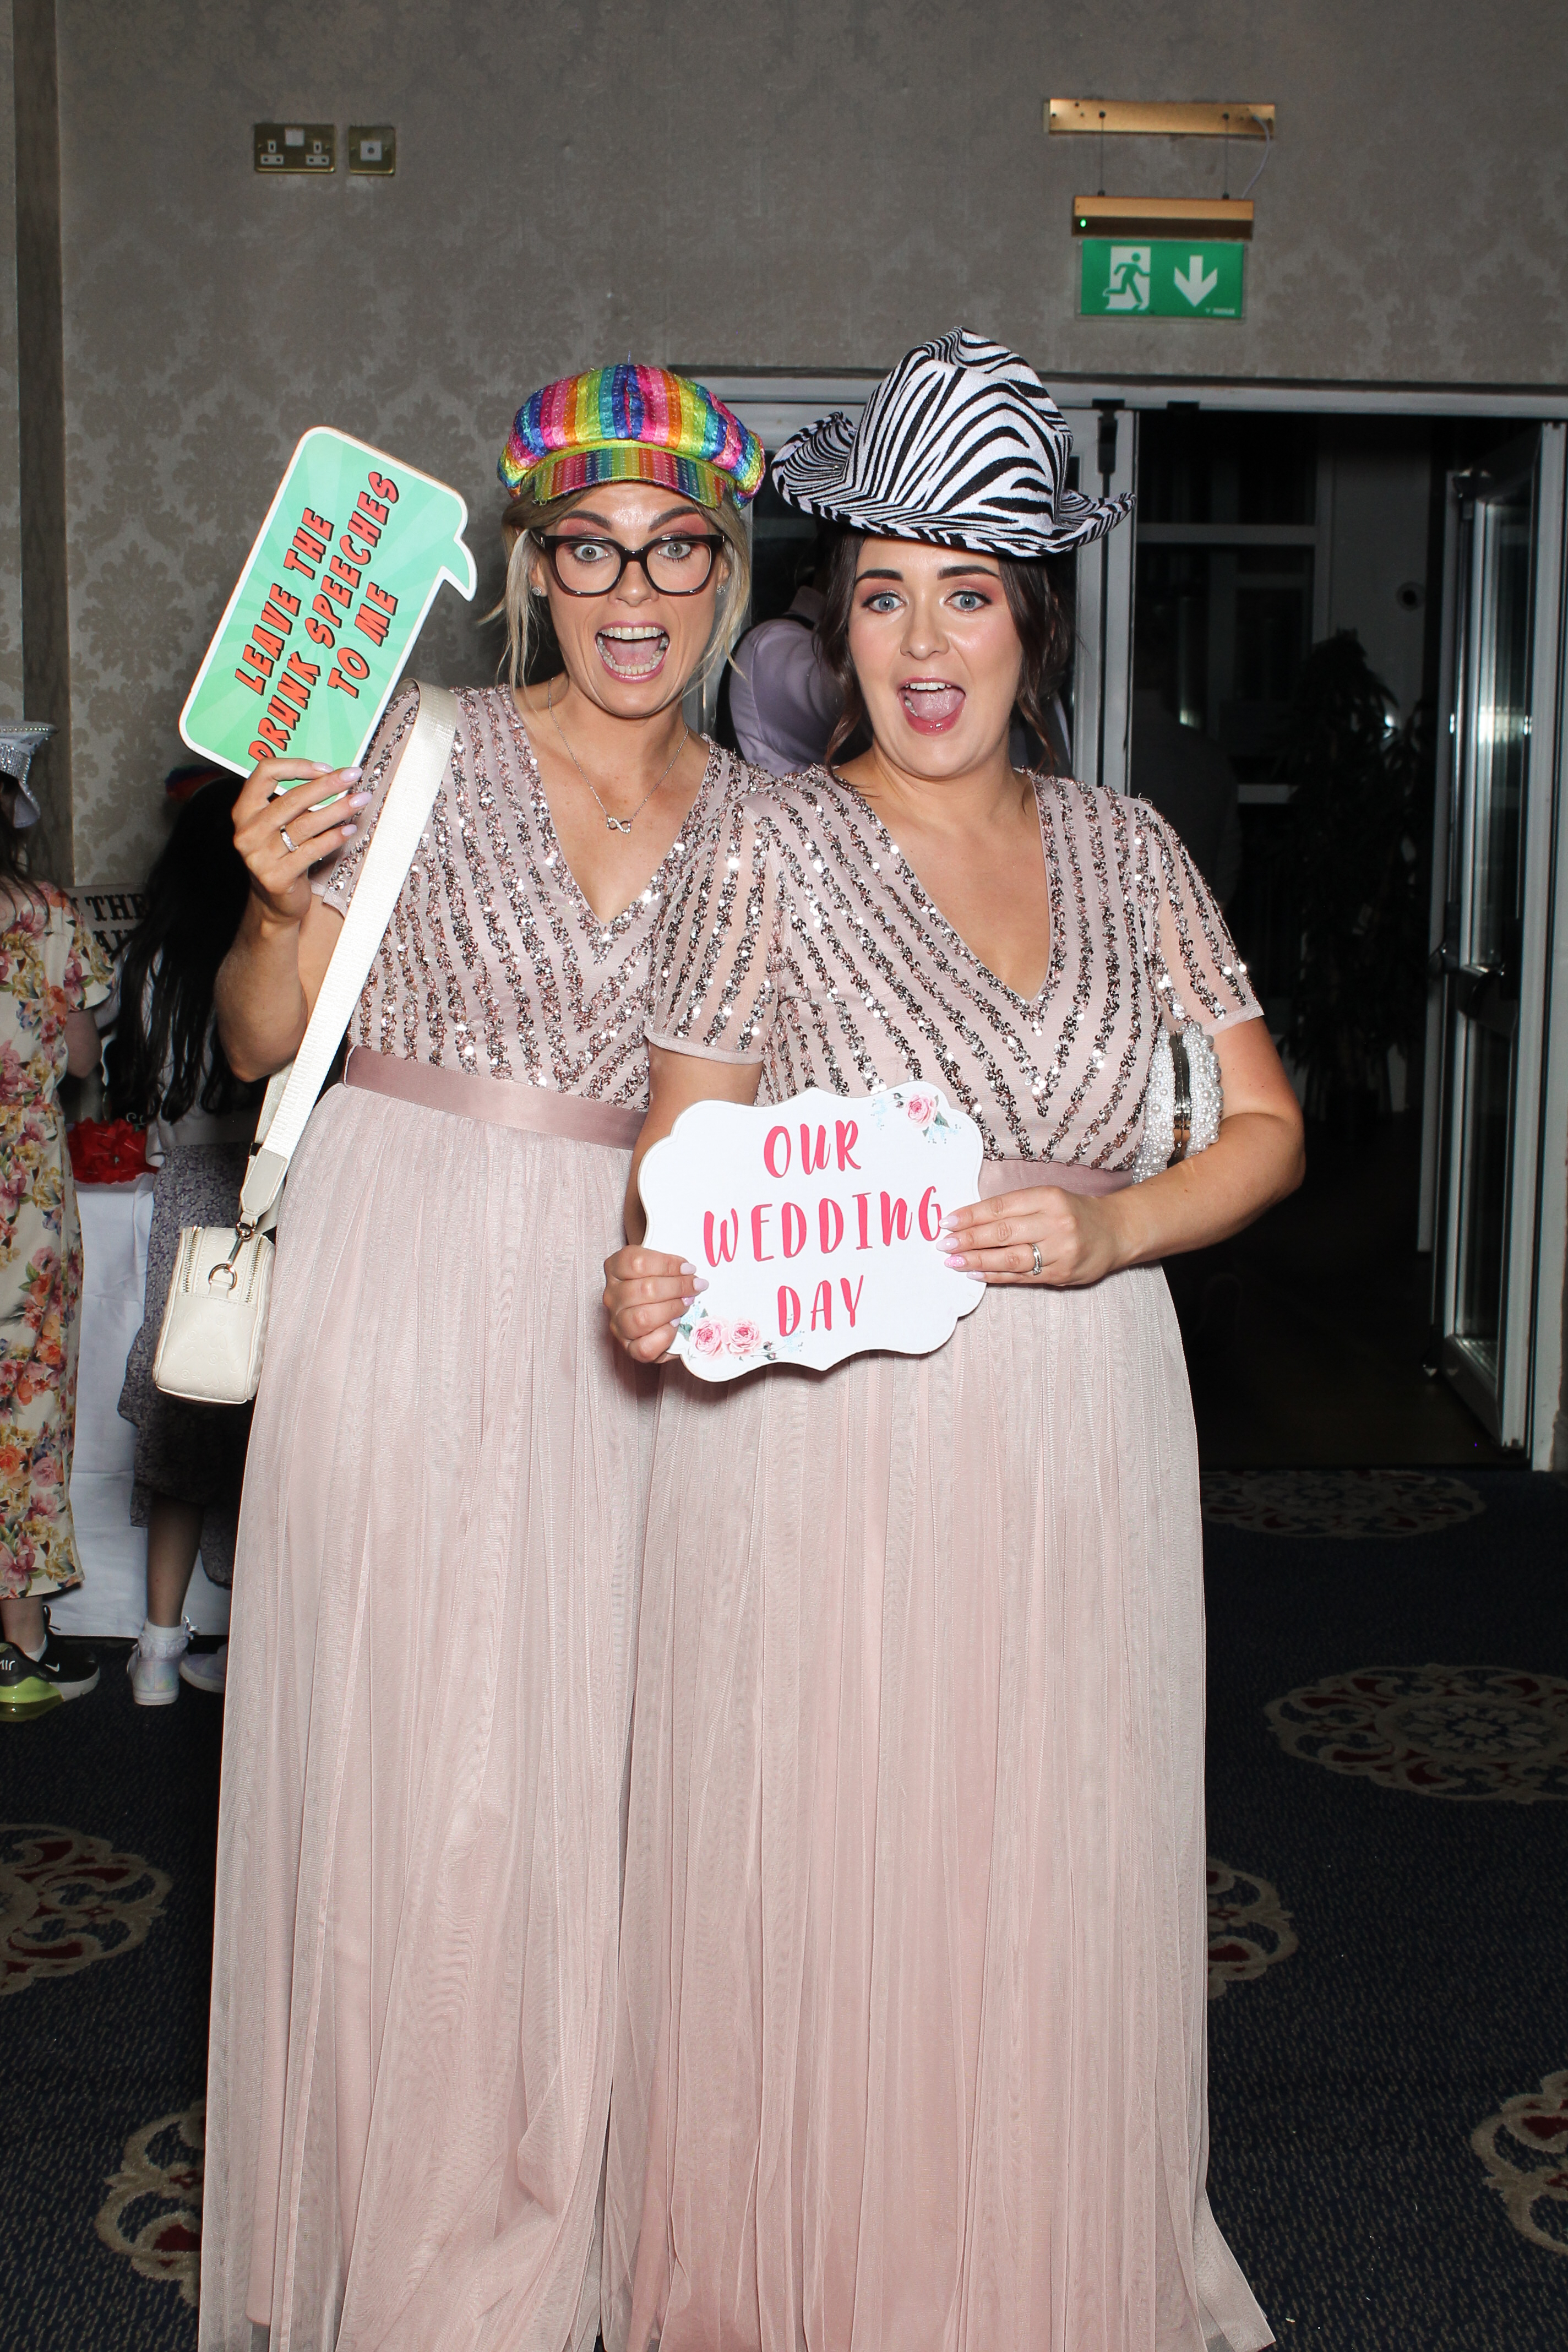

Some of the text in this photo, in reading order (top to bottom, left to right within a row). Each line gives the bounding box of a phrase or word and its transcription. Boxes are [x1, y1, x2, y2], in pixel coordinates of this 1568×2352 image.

[235, 507, 334, 695] LEAVE THE
[248, 471, 399, 762] DRUNK SPEECHES
[328, 582, 398, 698] TO ME
[84, 893, 146, 921] THE
[764, 1120, 861, 1178] OUR
[703, 1186, 942, 1267] WEDDING
[777, 1275, 864, 1336] DAY
